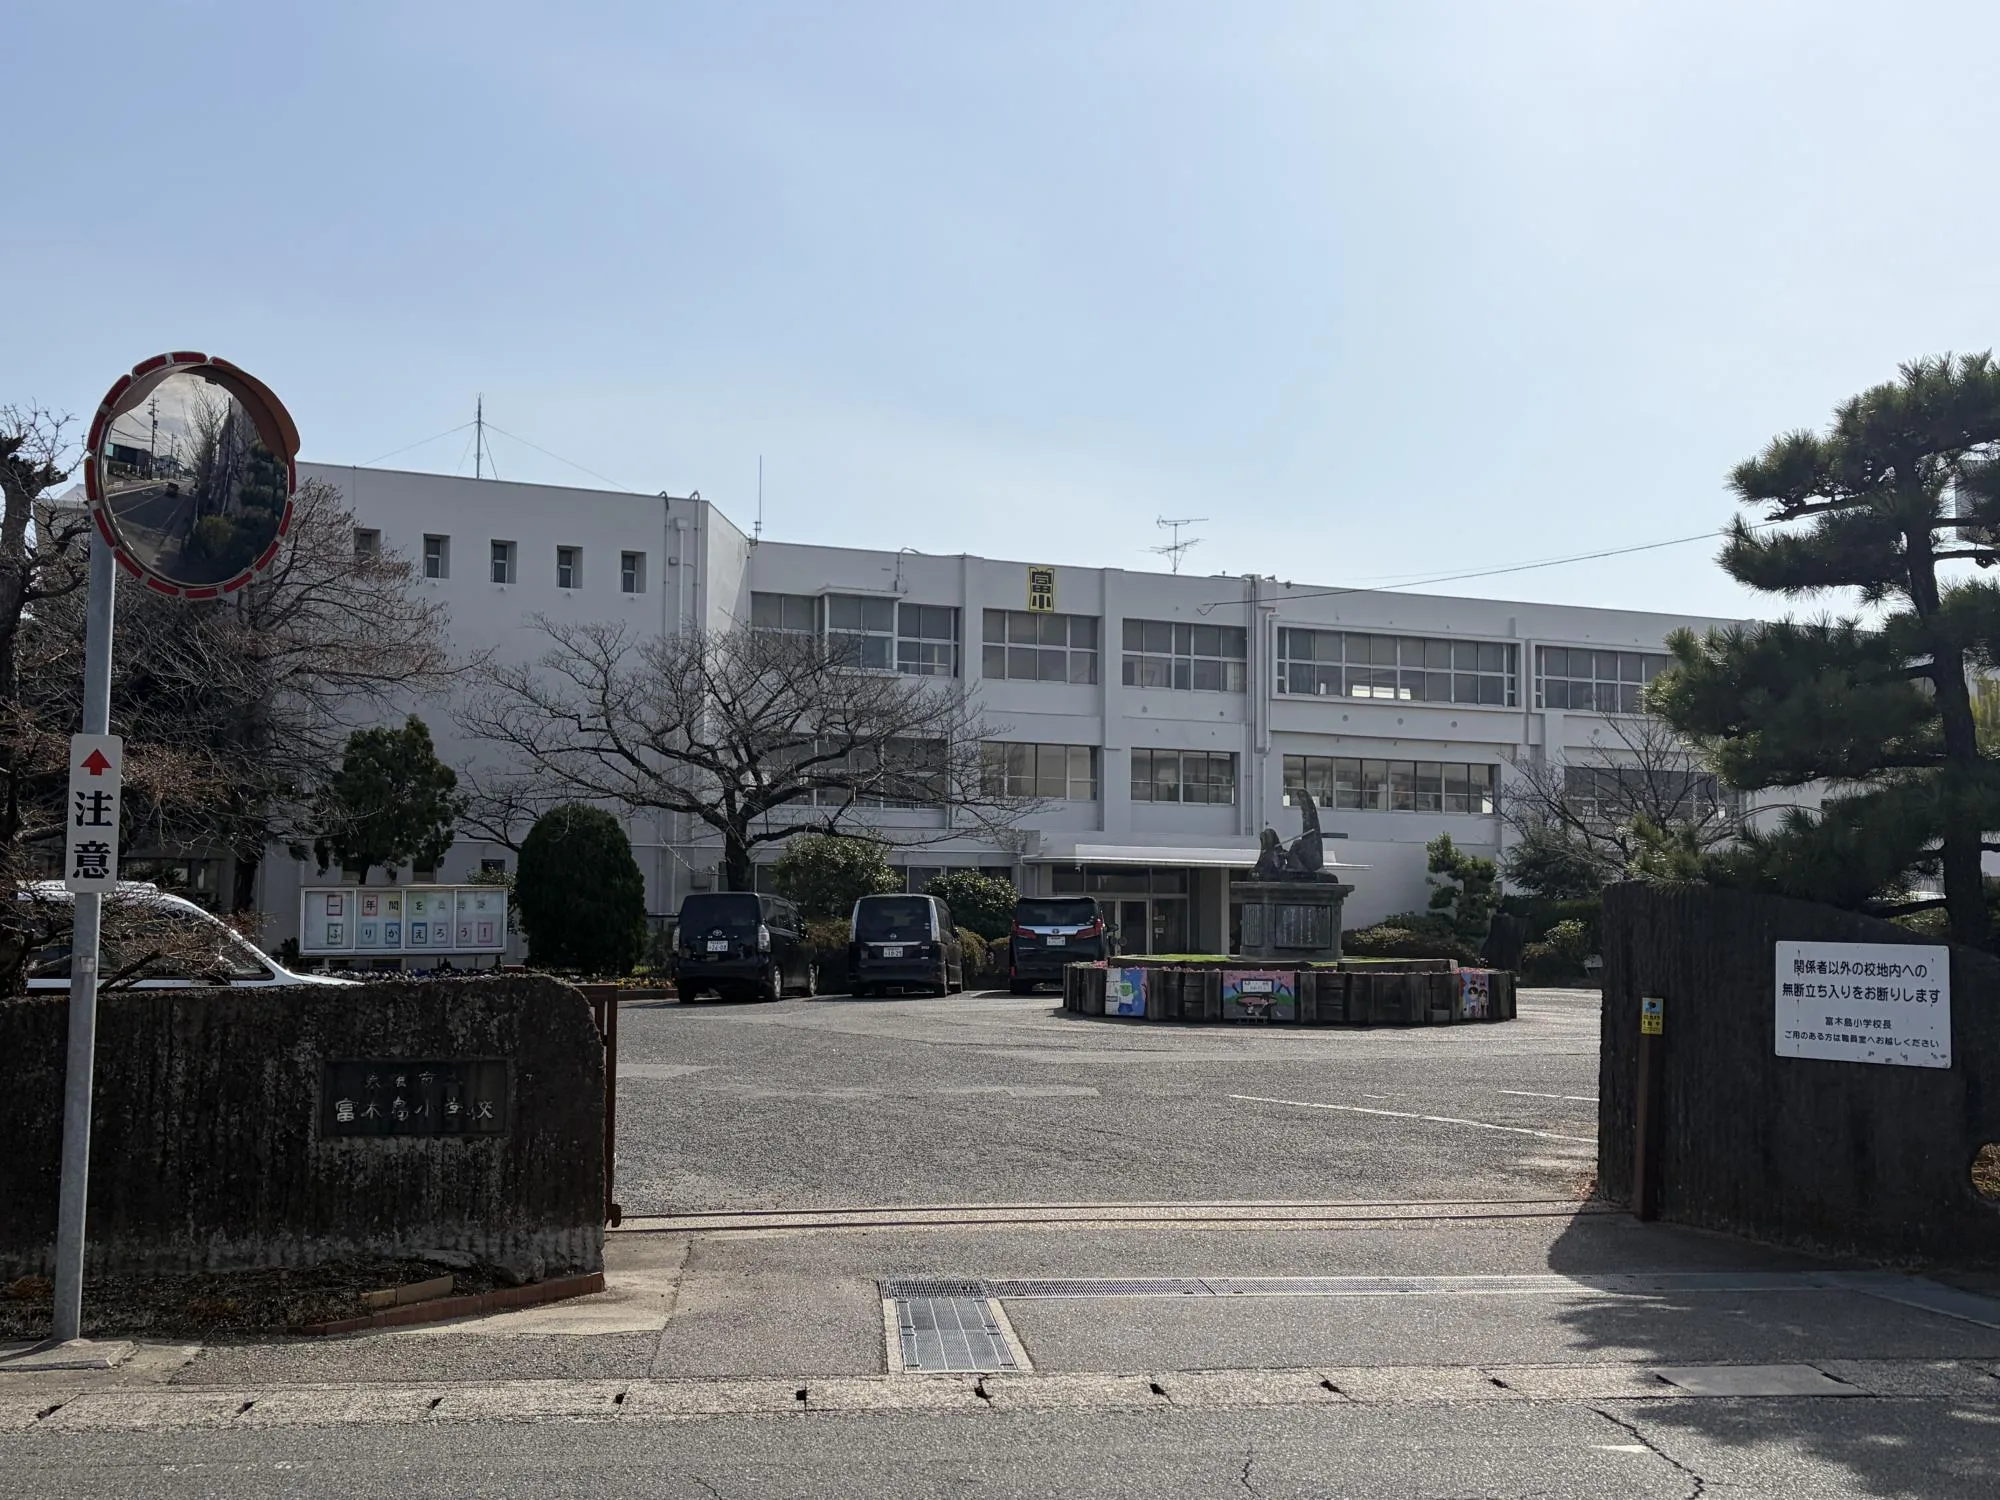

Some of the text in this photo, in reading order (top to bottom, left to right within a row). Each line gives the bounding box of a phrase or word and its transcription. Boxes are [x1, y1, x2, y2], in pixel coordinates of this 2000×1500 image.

[73, 790, 114, 879] 注意
[1793, 959, 1928, 978] 関係者以外の校地内への
[1782, 982, 1941, 1004] 無断立ち入りをお断りします
[1825, 1016, 1893, 1030] 富木島小学校長
